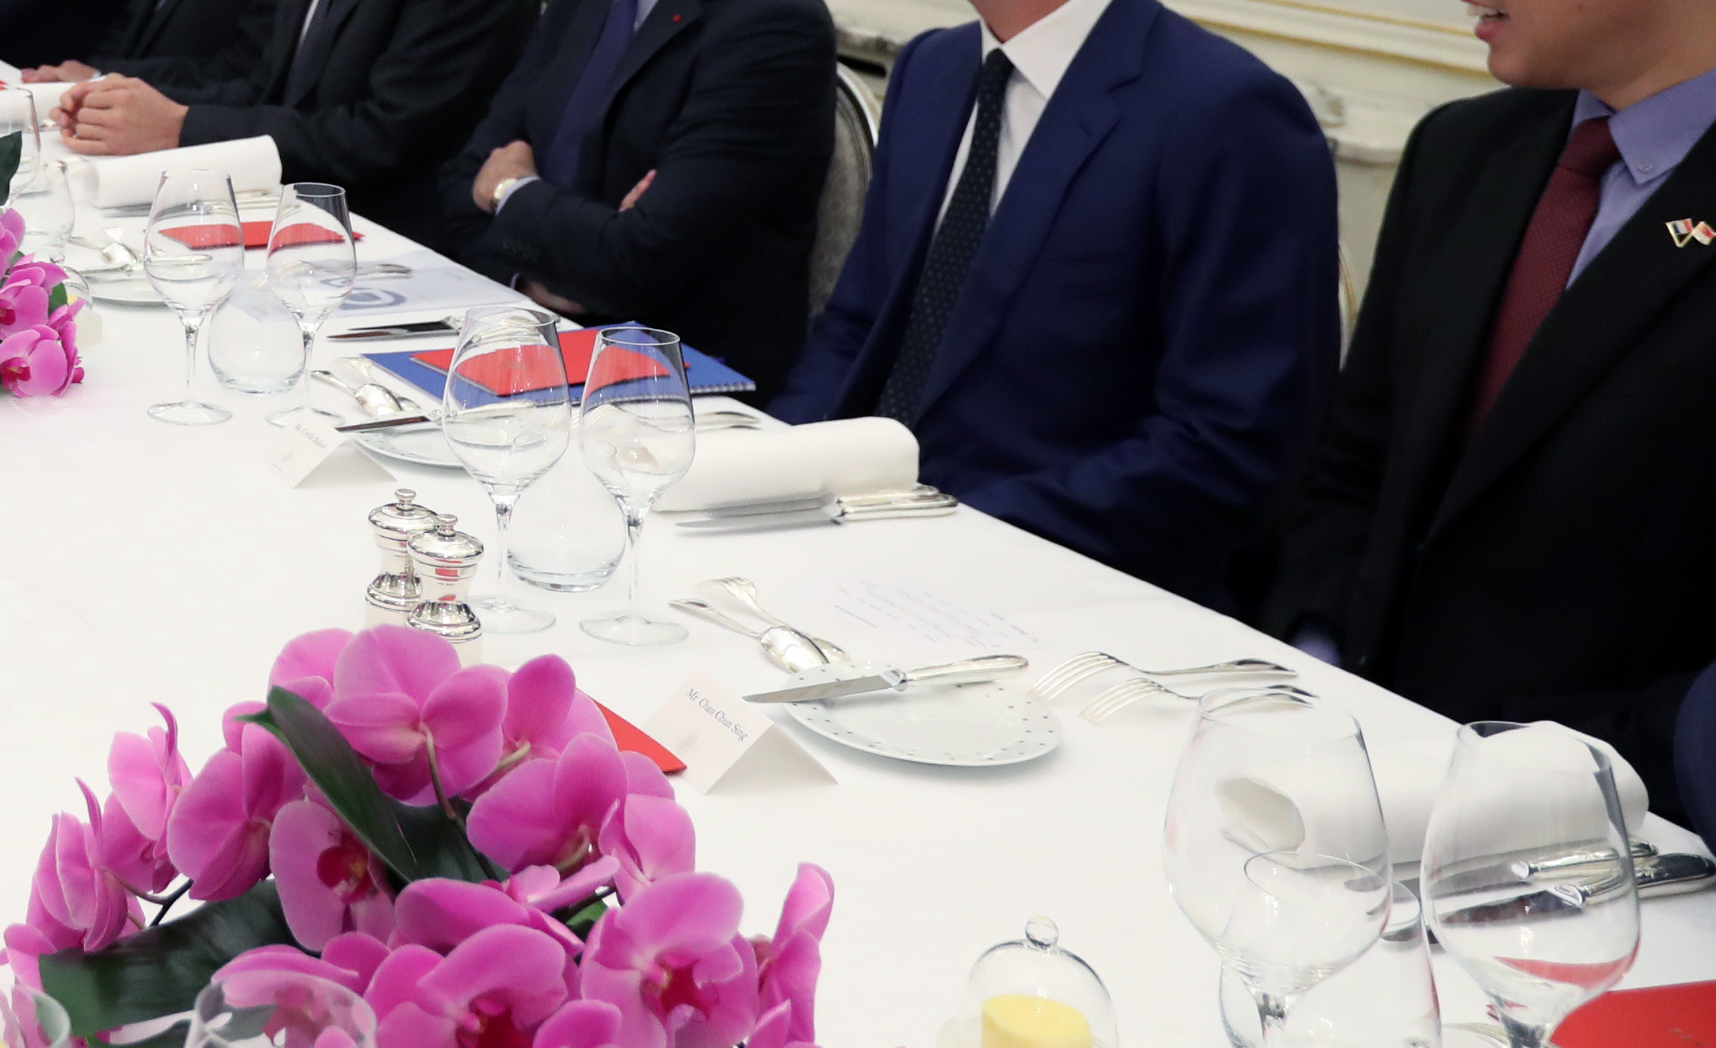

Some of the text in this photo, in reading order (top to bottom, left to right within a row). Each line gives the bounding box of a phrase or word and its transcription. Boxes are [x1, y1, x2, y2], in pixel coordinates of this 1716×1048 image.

[699, 698, 715, 715] Chan
[715, 711, 732, 728] Chun
[731, 724, 748, 742] Sing
